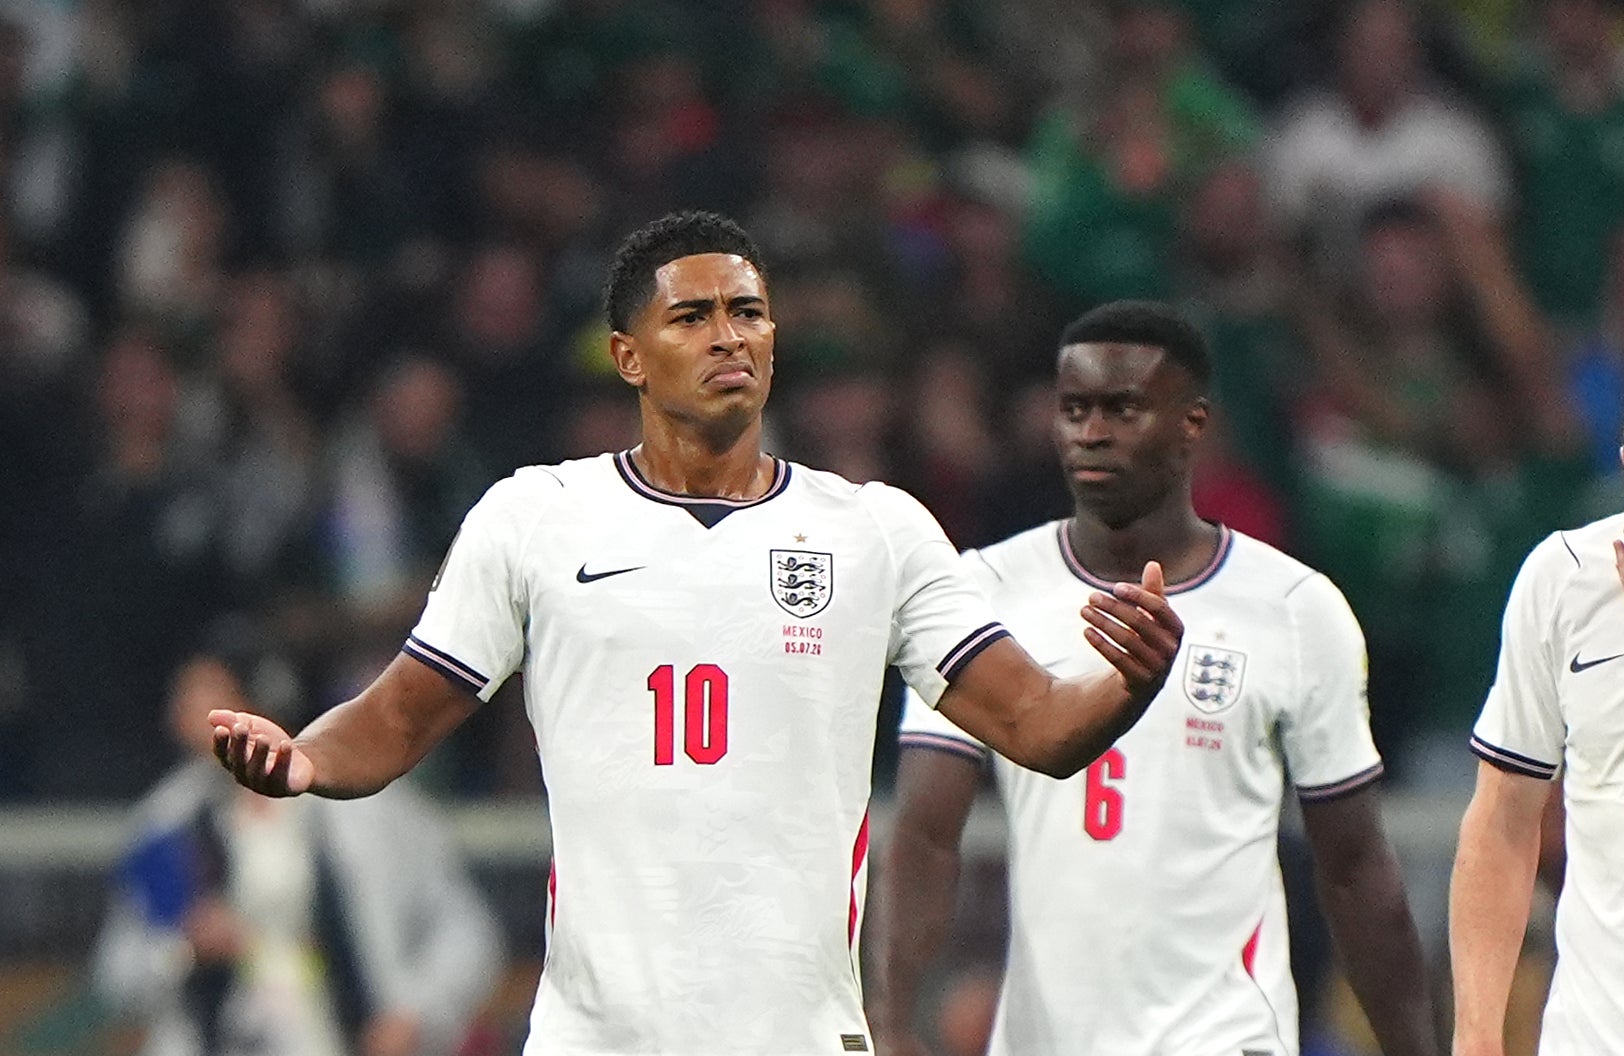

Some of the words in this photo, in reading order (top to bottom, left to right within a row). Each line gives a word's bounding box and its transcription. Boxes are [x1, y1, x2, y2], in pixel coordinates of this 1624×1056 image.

[782, 625, 823, 640] MEXICO
[647, 664, 728, 765] 10
[1084, 747, 1126, 841] 6
